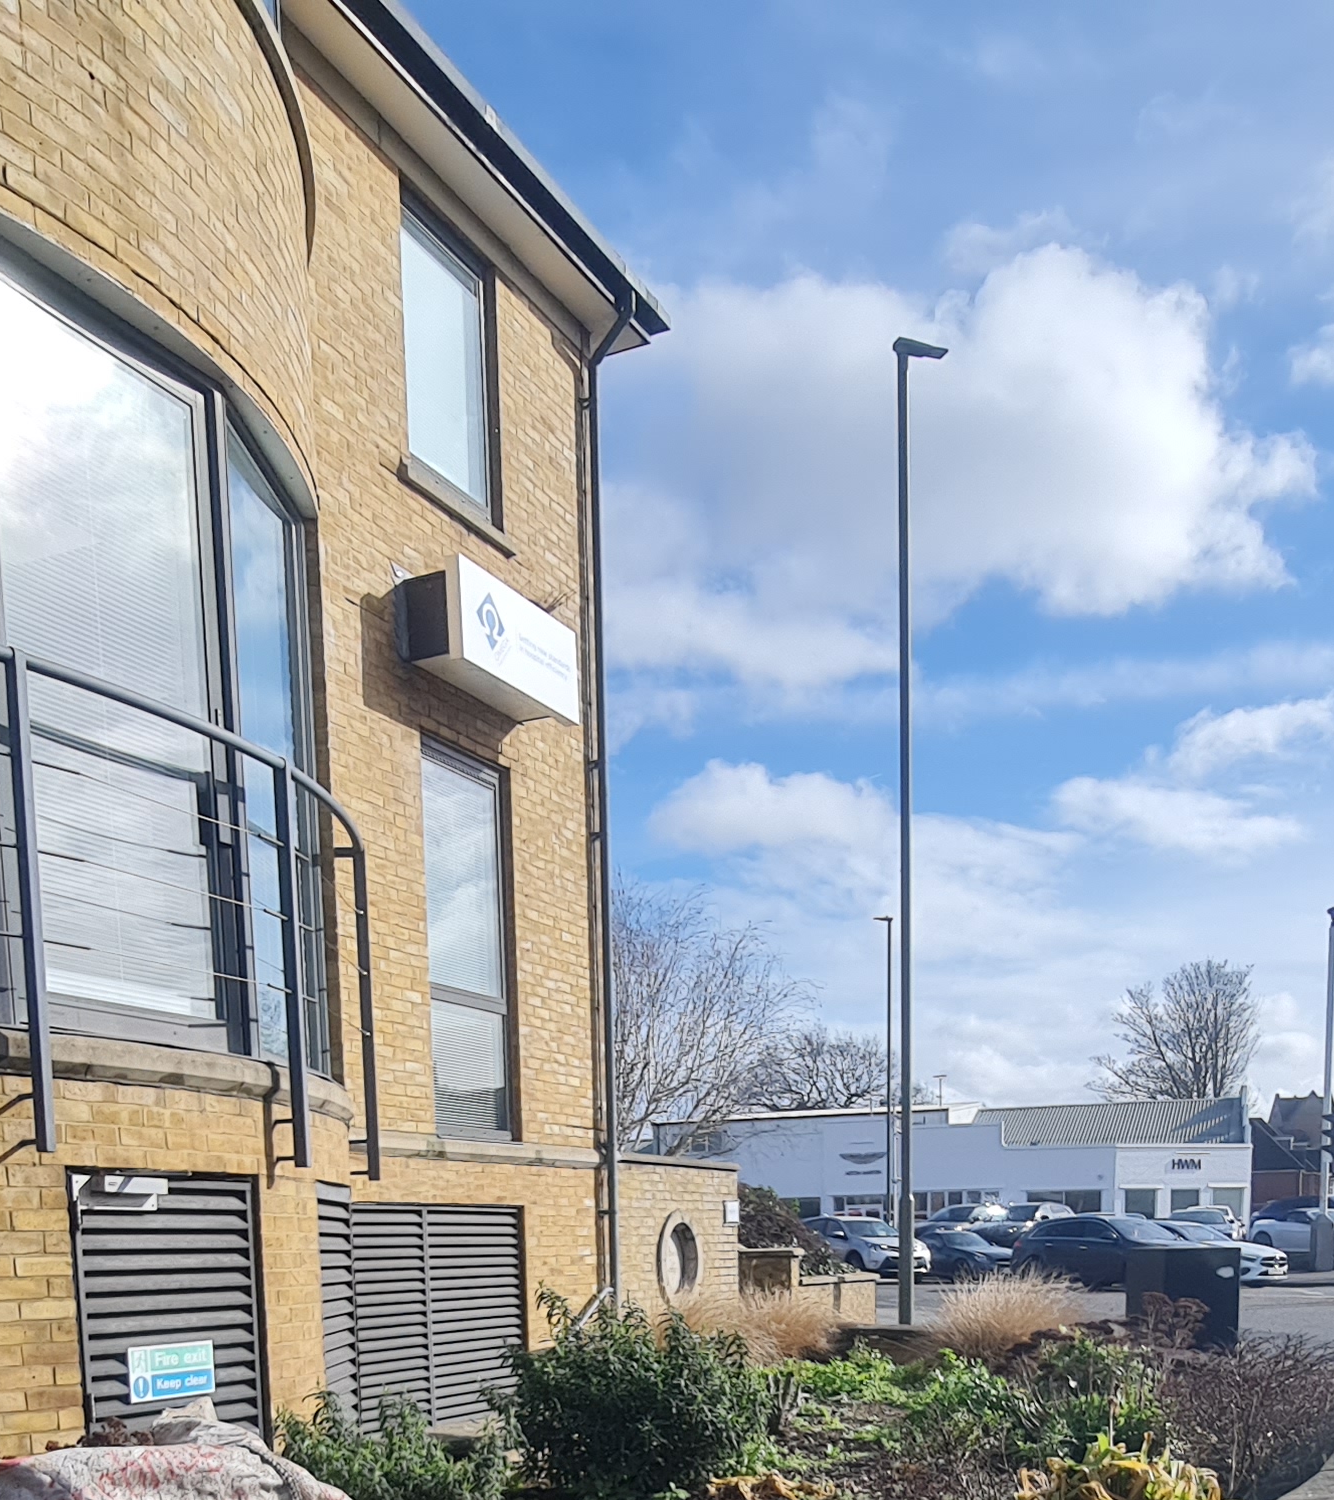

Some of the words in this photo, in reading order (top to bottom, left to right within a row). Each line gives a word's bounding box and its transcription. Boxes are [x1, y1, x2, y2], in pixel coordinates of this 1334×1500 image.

[1172, 1158, 1201, 1170] HWM
[155, 1351, 179, 1367] Fire
[184, 1348, 207, 1364] exit
[156, 1378, 182, 1390] Keep
[185, 1374, 208, 1386] clear
